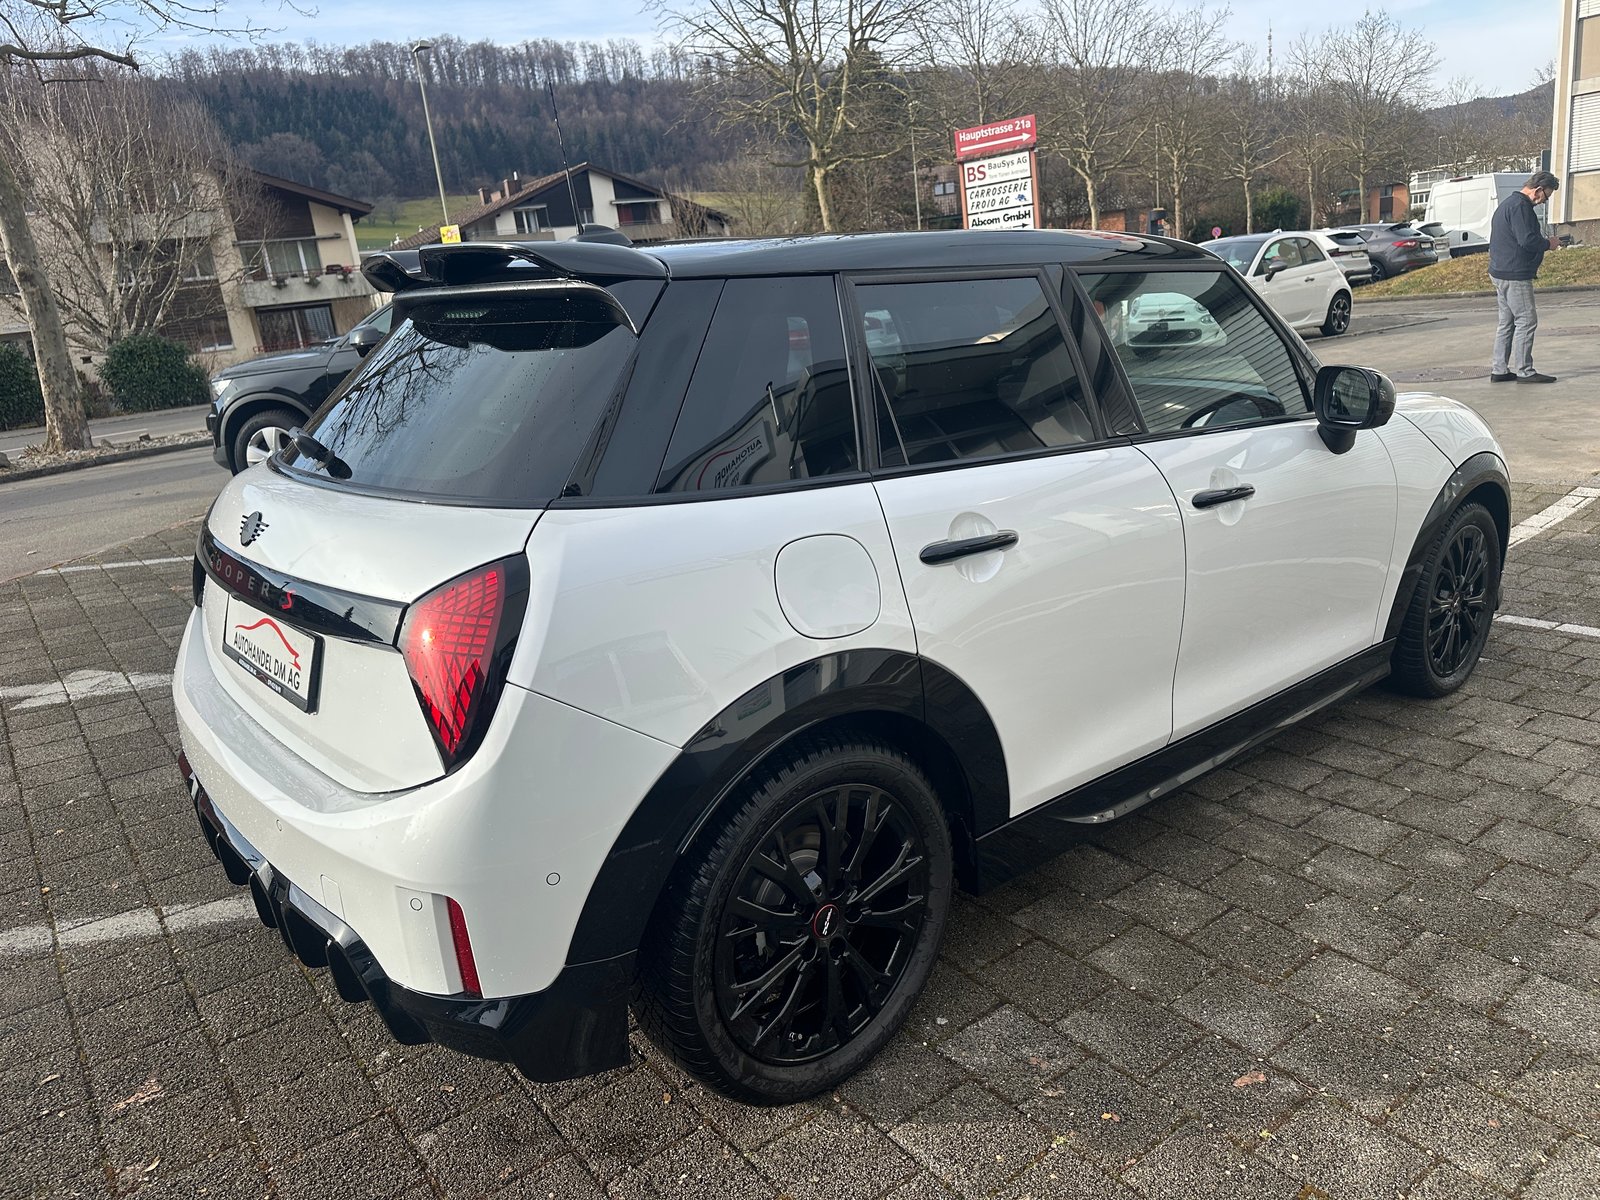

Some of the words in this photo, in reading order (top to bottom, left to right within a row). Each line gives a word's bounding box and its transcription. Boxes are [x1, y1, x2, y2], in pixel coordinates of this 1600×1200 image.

[959, 123, 1013, 142] Hauptstrasse
[1015, 119, 1031, 131] 21a
[987, 159, 1015, 170] BauSys
[1016, 156, 1028, 165] AG
[967, 164, 987, 183] BS
[969, 181, 1028, 199] CARROSSERIE
[970, 199, 996, 211] FROIO
[998, 195, 1010, 206] AG
[971, 217, 1000, 228] Abcom
[1002, 209, 1031, 222] GmbH
[210, 553, 270, 597] COOPER
[281, 591, 294, 609] S
[233, 631, 272, 673] AUTOHANDEL
[273, 658, 286, 682] DM
[287, 668, 301, 691] AG
